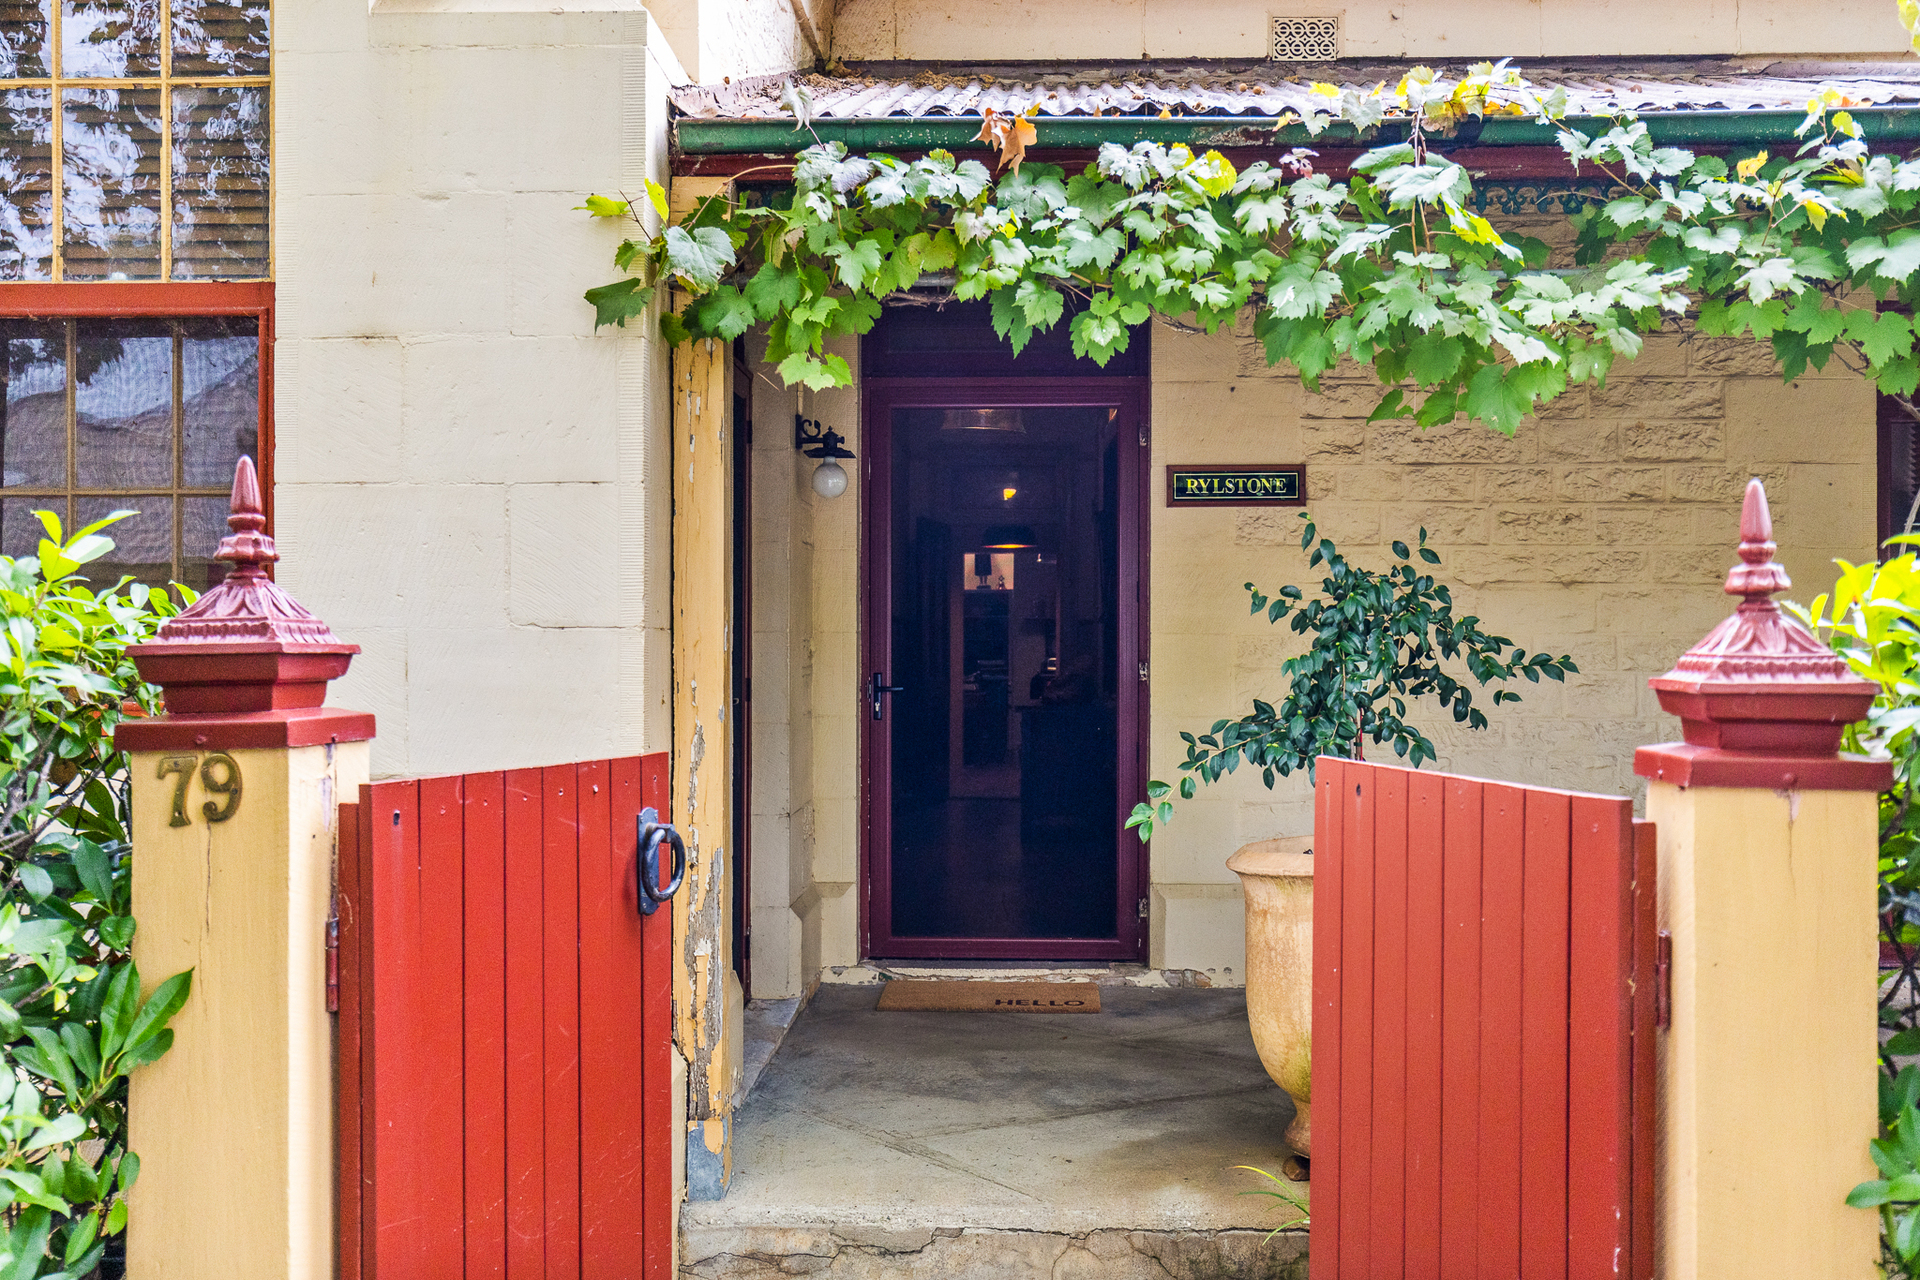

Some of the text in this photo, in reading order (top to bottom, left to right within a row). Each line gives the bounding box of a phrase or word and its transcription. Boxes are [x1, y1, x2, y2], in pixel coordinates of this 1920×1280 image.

[1186, 478, 1287, 494] RYLSTONE
[156, 753, 243, 827] 79
[994, 999, 1085, 1007] HELLO
